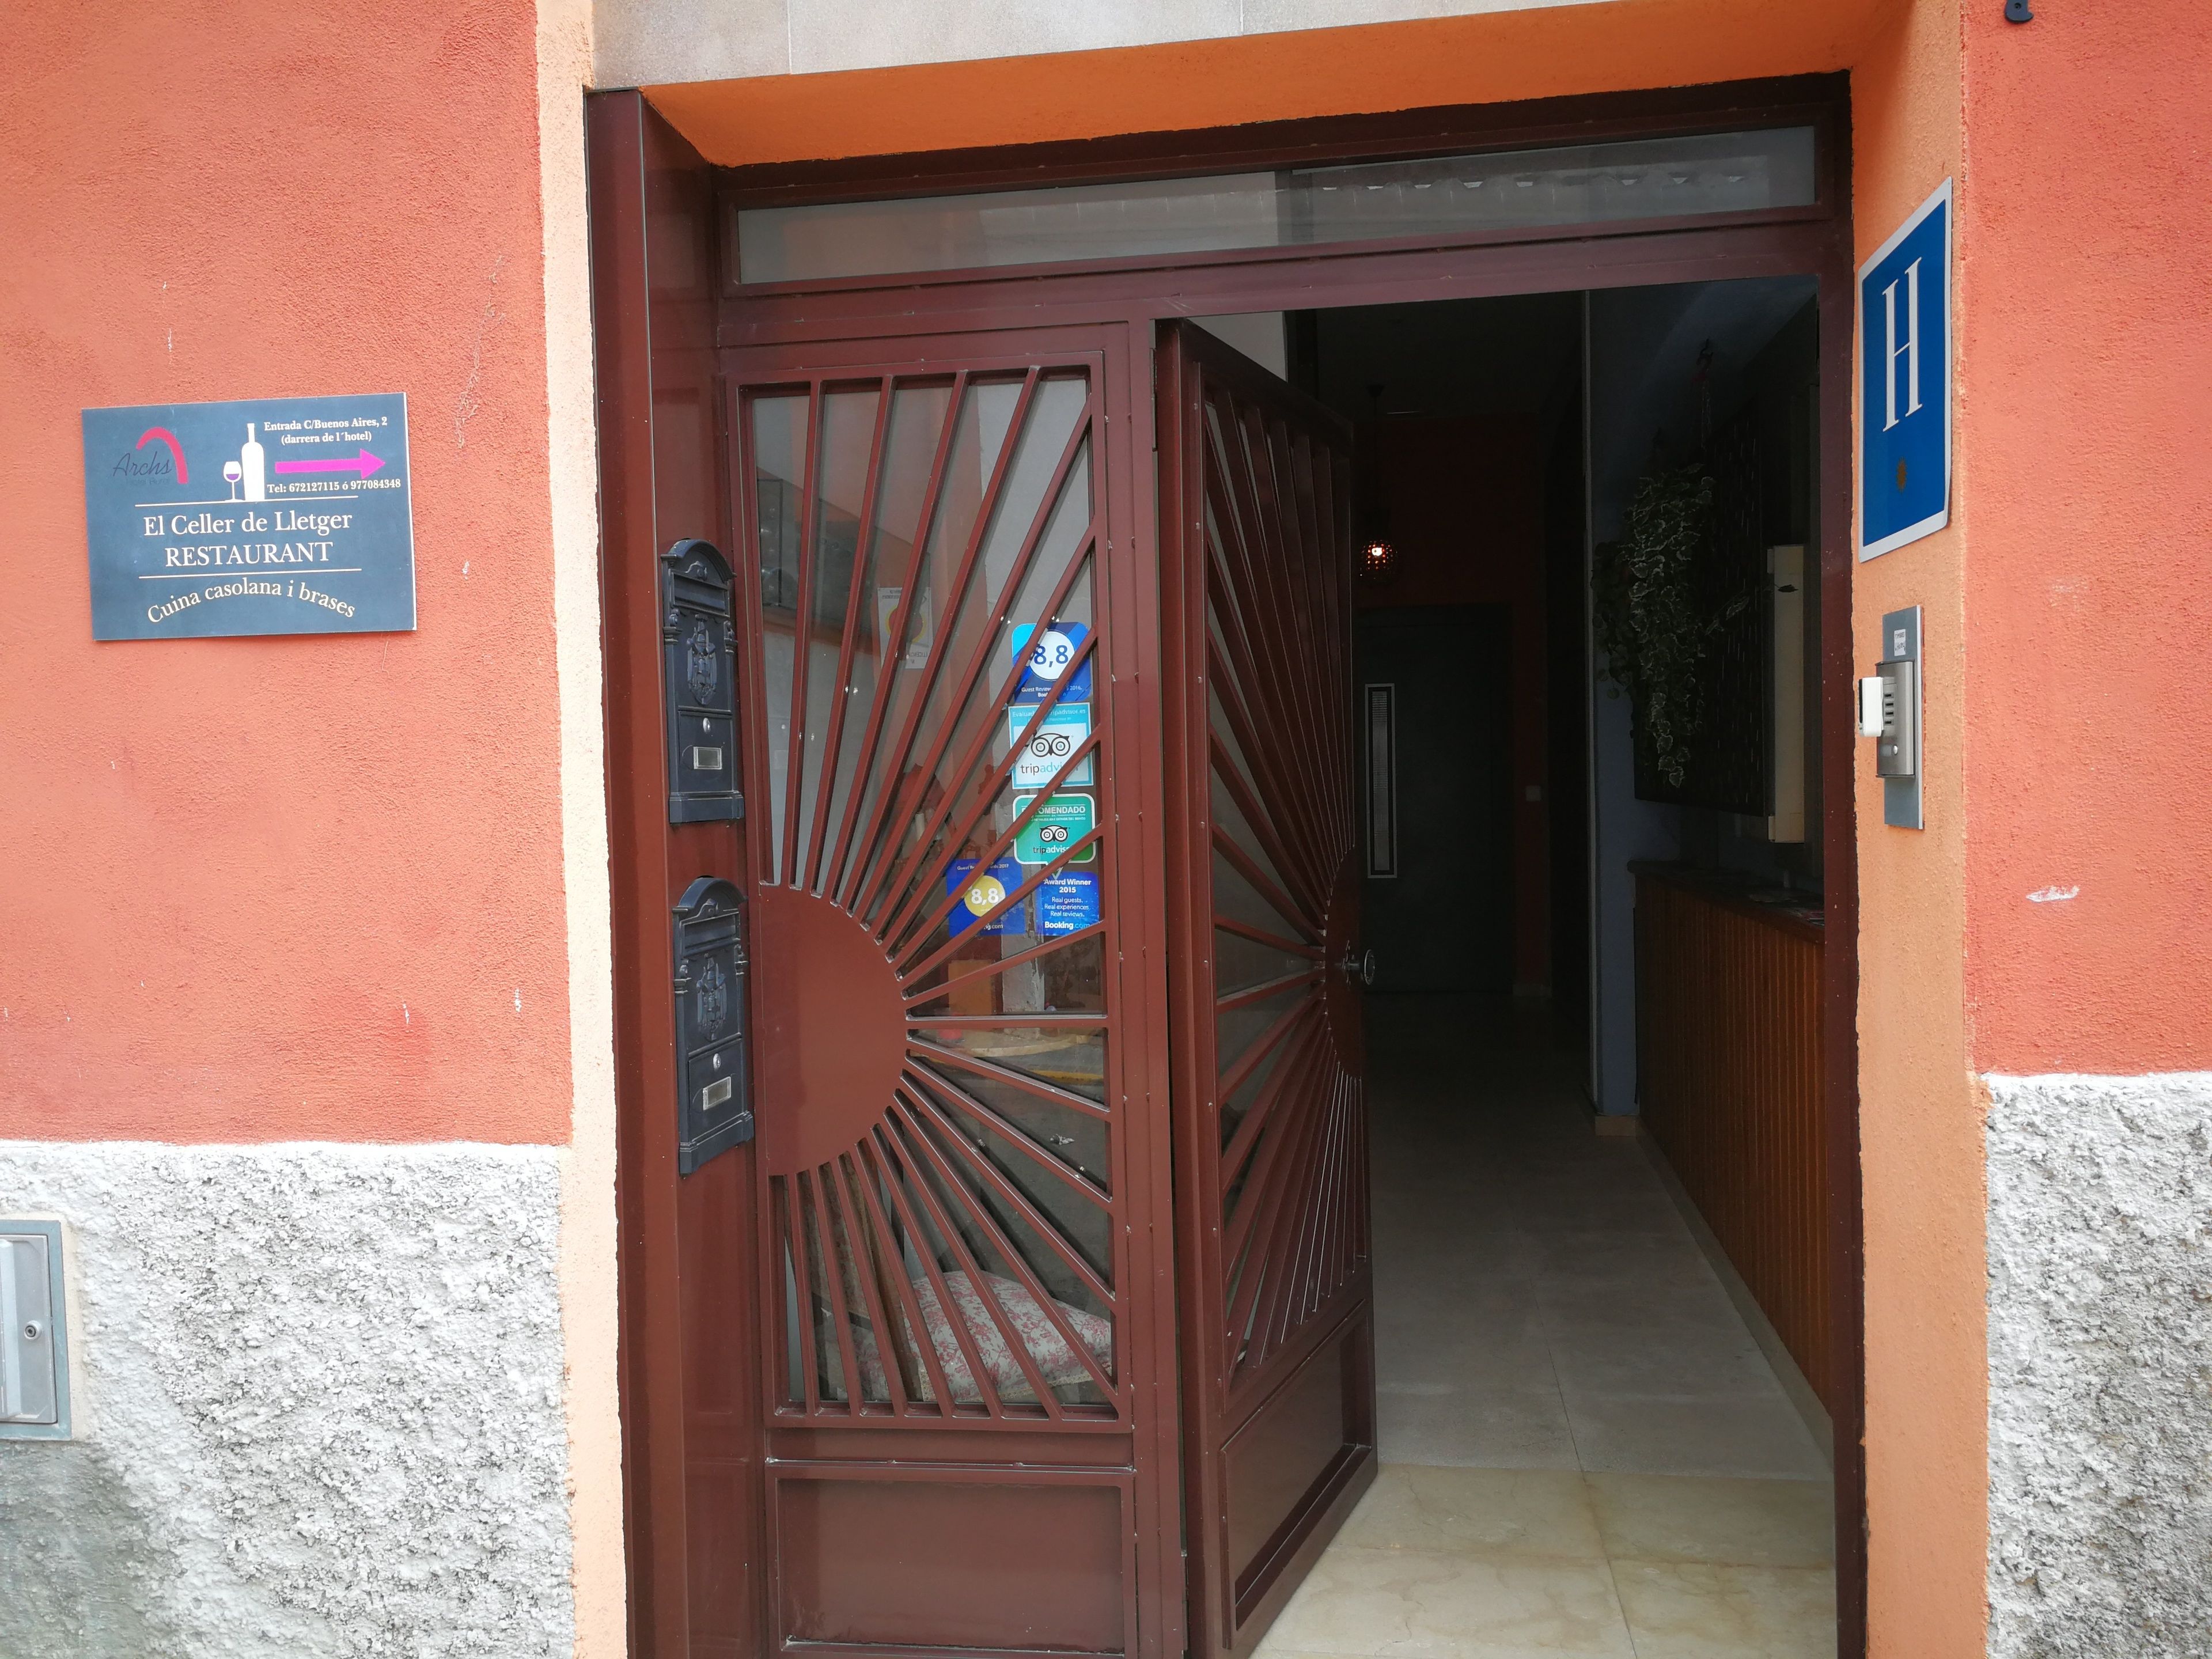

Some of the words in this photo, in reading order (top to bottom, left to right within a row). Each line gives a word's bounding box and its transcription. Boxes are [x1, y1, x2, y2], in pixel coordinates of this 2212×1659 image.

[264, 421, 301, 431] Entrada
[304, 420, 349, 430] C/Buenos
[351, 418, 379, 427] Aires,
[381, 416, 387, 426] 2
[281, 434, 320, 445] (darrera
[322, 433, 334, 442] de
[113, 451, 172, 476] Archs
[267, 484, 286, 493] Tel:
[289, 482, 339, 493] 672127115
[343, 482, 349, 490] ó
[351, 479, 401, 490] 977084348
[143, 516, 165, 536] El
[171, 513, 234, 535] Celler
[241, 512, 267, 532] de
[275, 510, 352, 536] Lletger
[165, 541, 333, 567] RESTAURANT
[147, 592, 201, 623] Cuina
[205, 577, 282, 600] casolana
[287, 579, 294, 597] i
[298, 582, 355, 618] brases
[1033, 645, 1069, 668] 8,8
[1021, 806, 1085, 814] OMENDADO
[1033, 845, 1070, 855] tripadvis
[971, 888, 999, 905] 8,8
[1045, 921, 1090, 929] Booking.com
